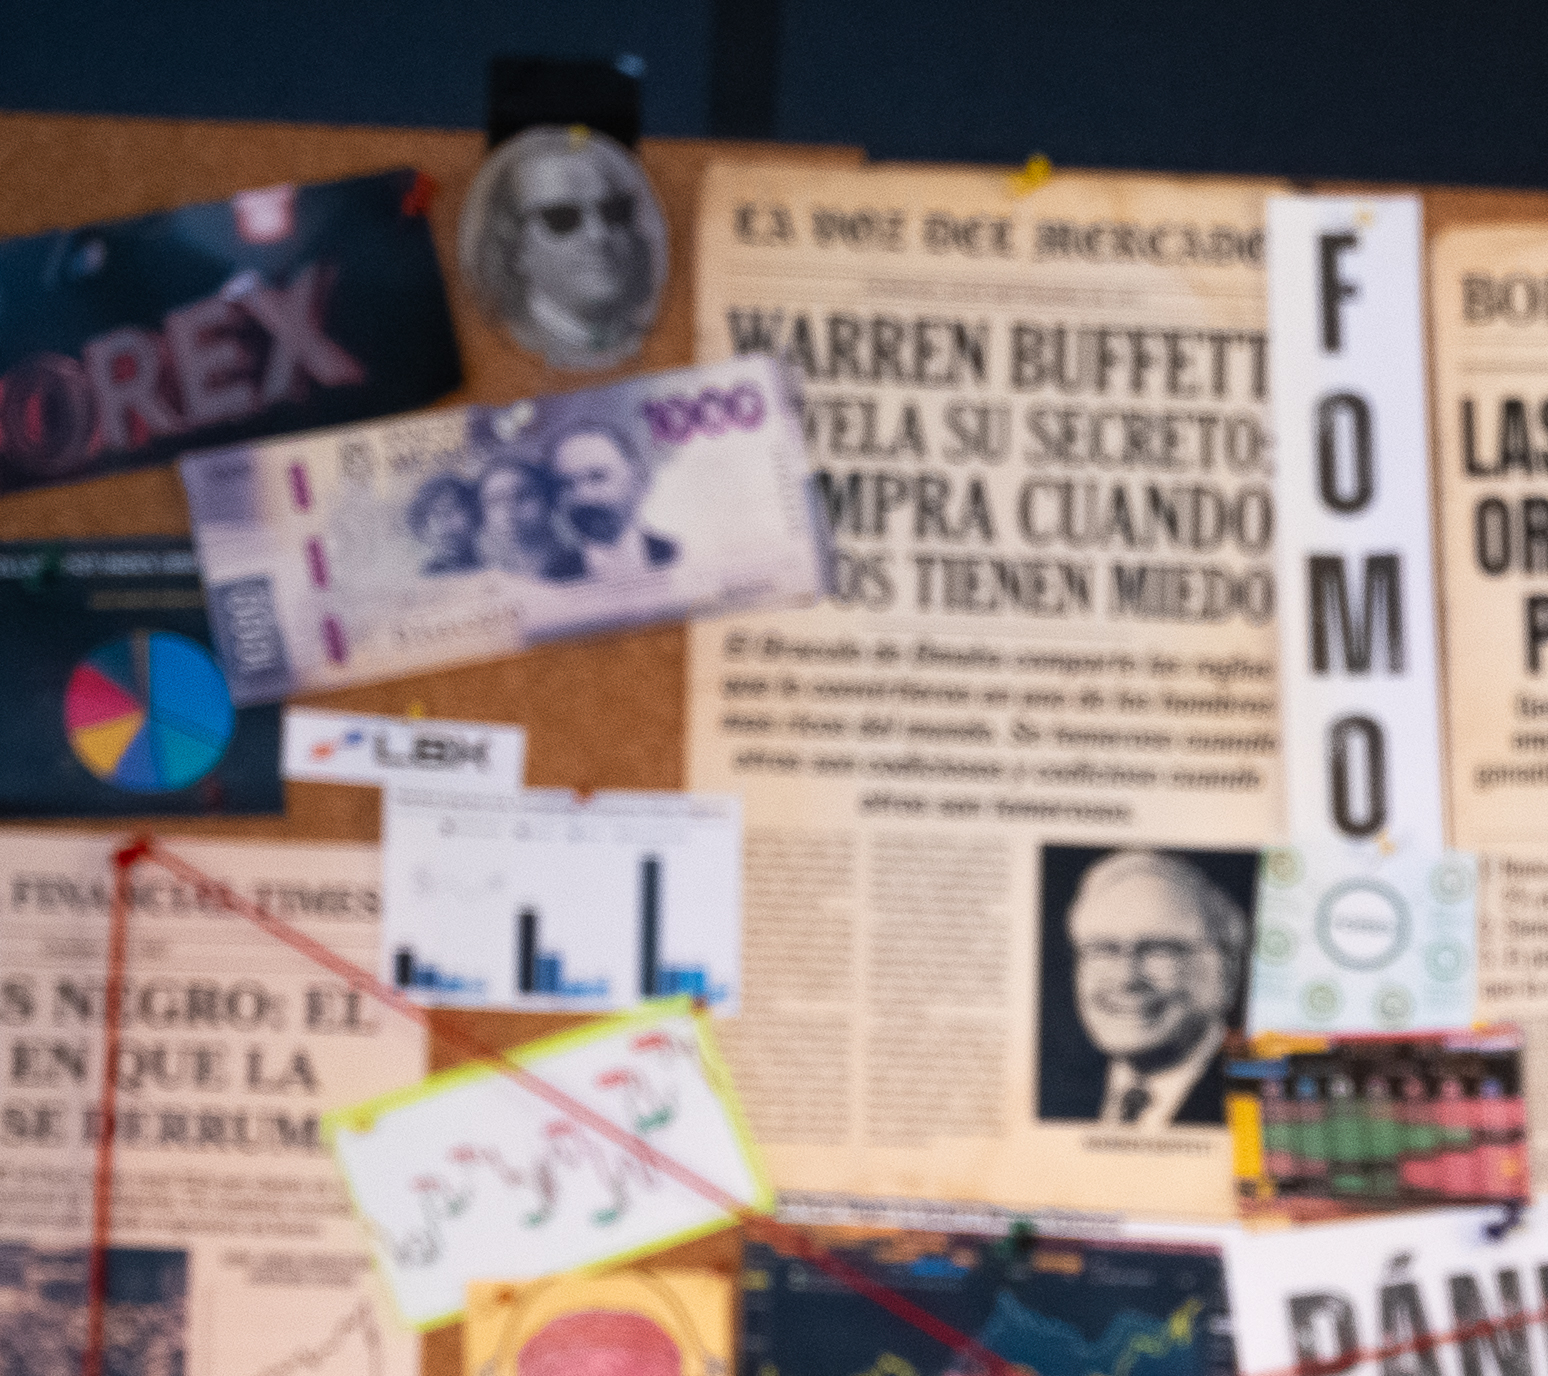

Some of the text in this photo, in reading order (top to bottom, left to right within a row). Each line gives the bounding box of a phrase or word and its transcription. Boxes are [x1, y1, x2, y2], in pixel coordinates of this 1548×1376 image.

[923, 211, 1013, 258] DEL
[727, 308, 1270, 398] WARREN BUFFETT
[942, 401, 1003, 461] SU
[1016, 476, 1276, 556] CUANDO
[1304, 230, 1412, 840] FOMO
[914, 555, 1276, 628] TIENEN MIEDO
[372, 734, 490, 770] LBX
[254, 884, 381, 918] TIMES
[53, 980, 384, 1034] NEGRO: EL
[10, 1043, 319, 1096] EN QUE LA
[3, 1104, 61, 1141] SE
